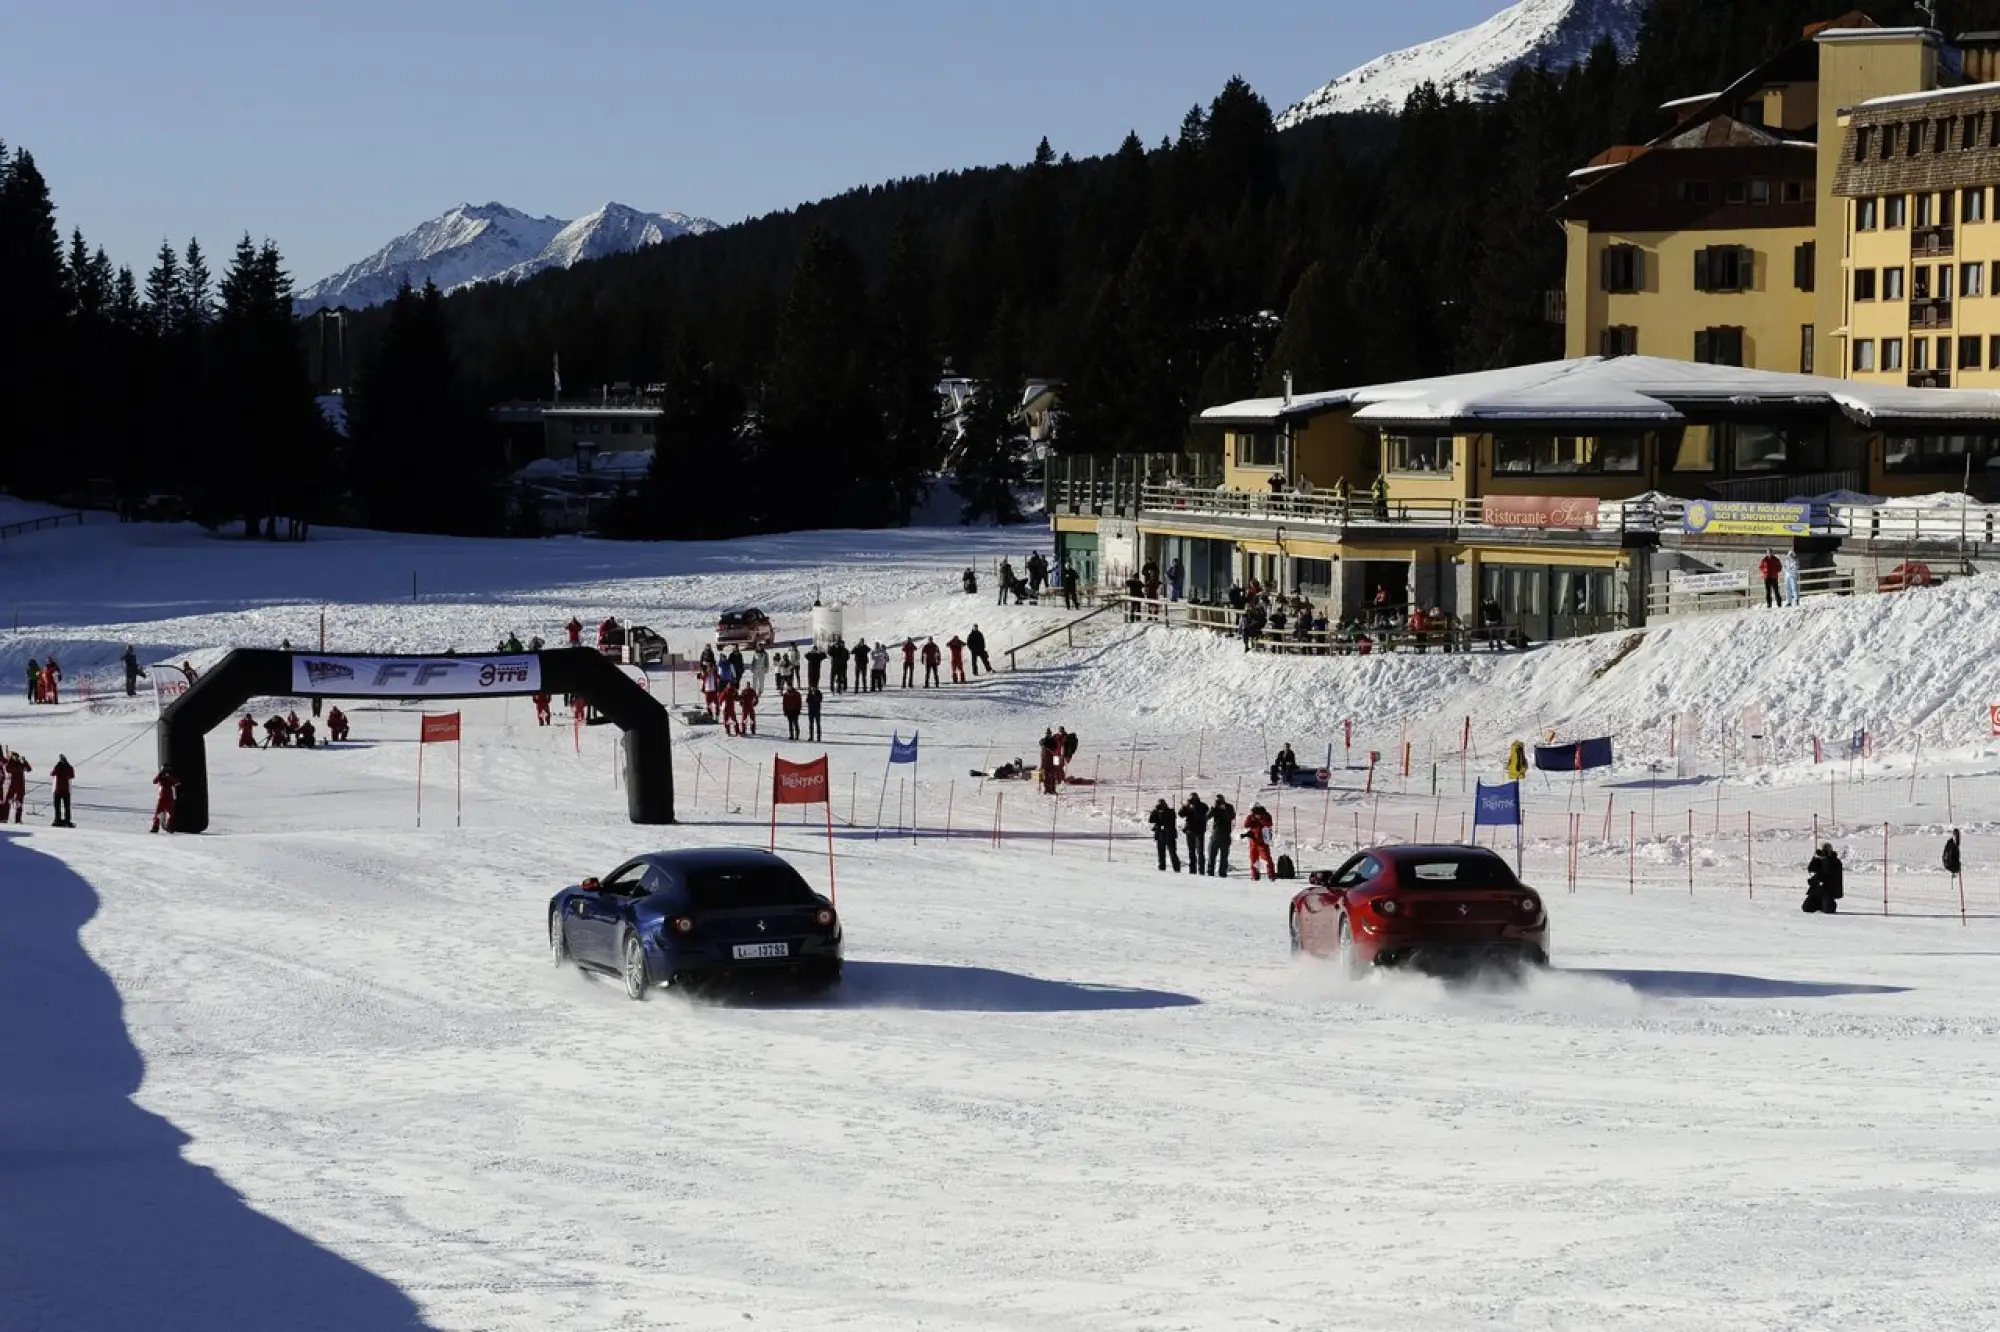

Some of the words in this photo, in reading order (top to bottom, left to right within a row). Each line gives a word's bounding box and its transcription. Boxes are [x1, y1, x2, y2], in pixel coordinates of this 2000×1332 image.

[1485, 508, 1548, 524] Ristorante
[1712, 503, 1747, 512] SCUOLA
[1758, 504, 1804, 514] NOLEGGIO
[1715, 512, 1731, 520] SCI
[371, 663, 460, 687] FF
[780, 772, 825, 788] TRENTINO
